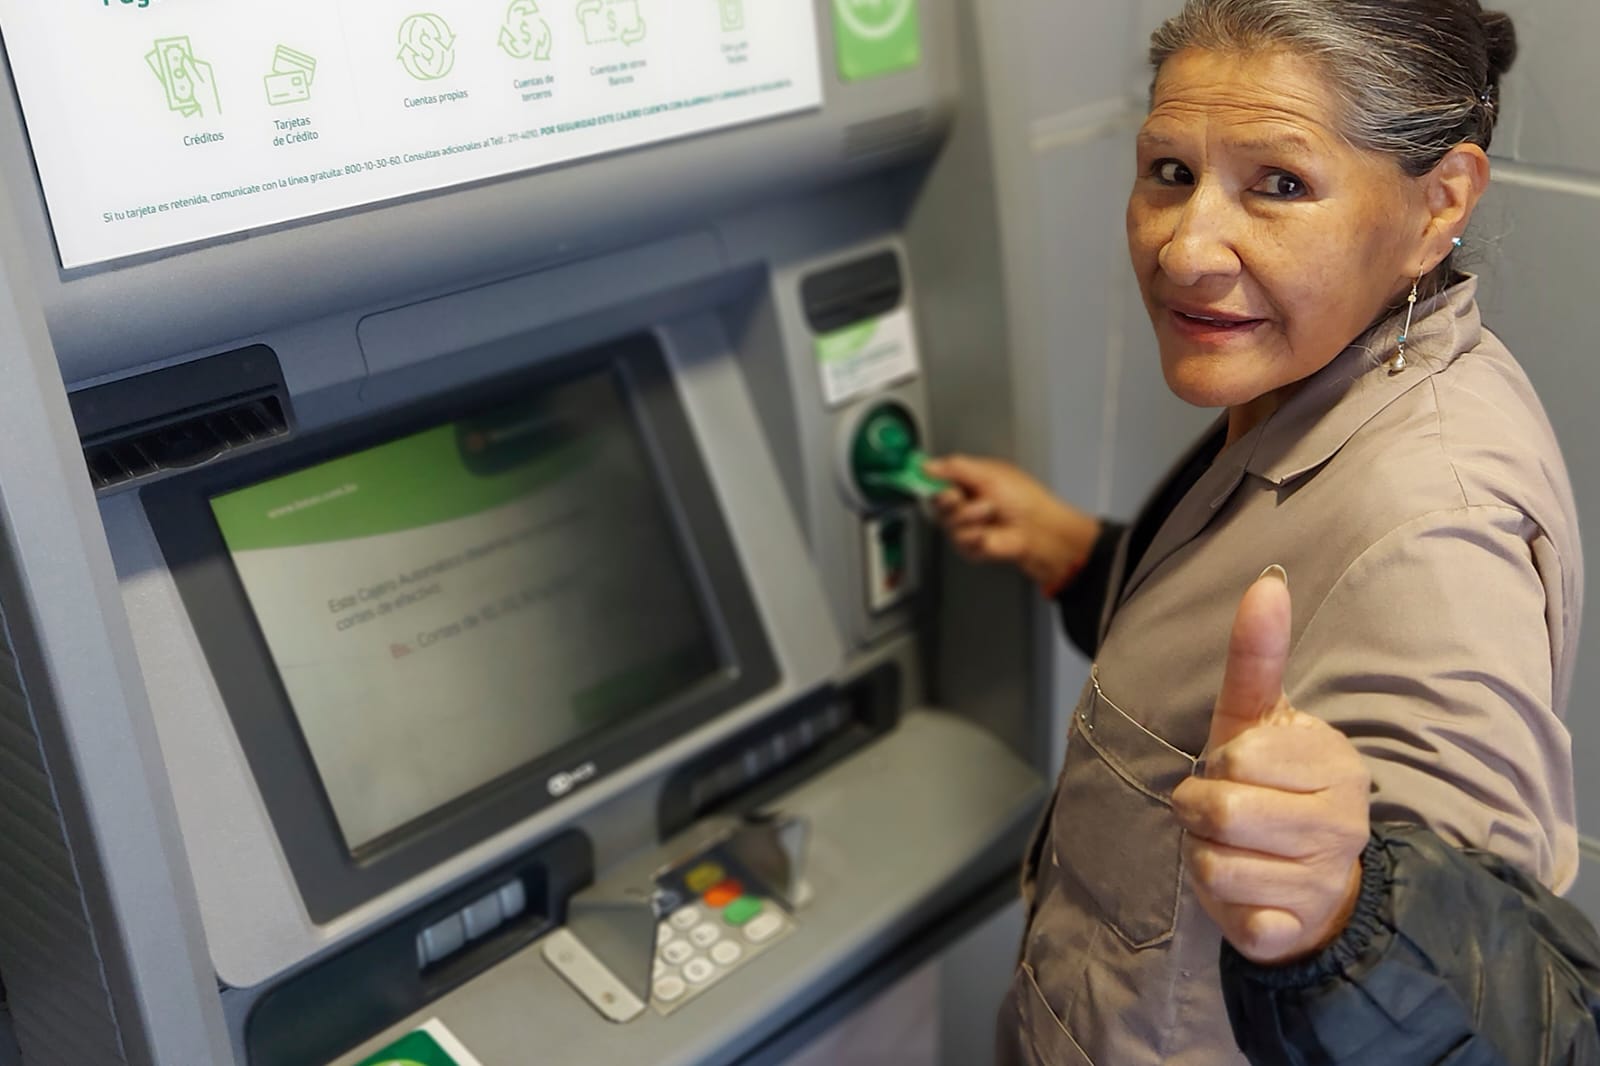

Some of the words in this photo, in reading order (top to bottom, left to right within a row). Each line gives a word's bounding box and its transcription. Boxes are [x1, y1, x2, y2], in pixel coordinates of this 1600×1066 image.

[513, 76, 544, 89] Cuentas
[545, 75, 555, 84] de
[403, 93, 437, 108] Cuentas
[438, 89, 468, 103] propias
[521, 89, 553, 102] terceros
[273, 117, 311, 131] Tarjetas
[183, 132, 225, 146] Créditos
[272, 137, 285, 147] de
[285, 131, 319, 145] Crédito
[103, 212, 114, 223] Si
[114, 211, 125, 221] tu
[126, 204, 157, 219] tarjeta
[158, 203, 170, 212] es
[170, 194, 211, 209] retenida,
[262, 181, 277, 191] con
[278, 178, 287, 188] la
[310, 168, 343, 184] gratuita:
[403, 150, 441, 164] Consultas
[441, 140, 482, 156] adicionales
[483, 137, 490, 147] al
[540, 124, 556, 136] POR
